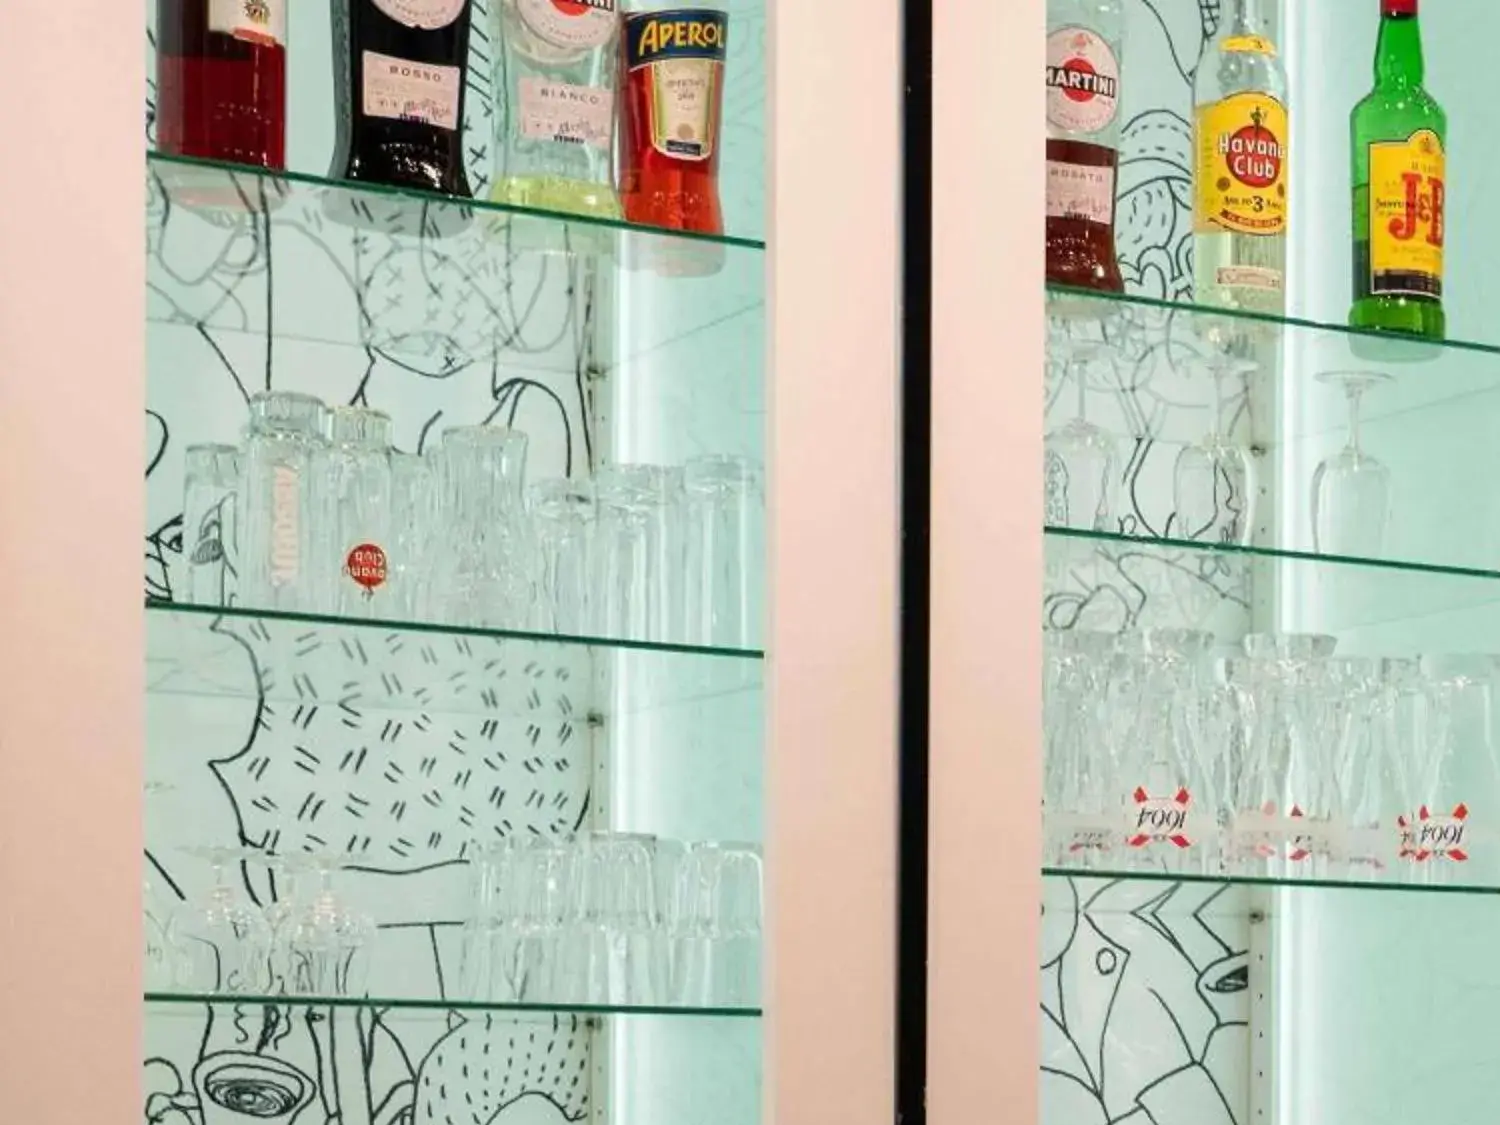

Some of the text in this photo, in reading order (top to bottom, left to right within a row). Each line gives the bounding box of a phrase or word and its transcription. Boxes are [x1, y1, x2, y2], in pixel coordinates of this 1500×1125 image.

[389, 65, 441, 82] ROSSO
[540, 88, 599, 104] BIANCO
[1233, 156, 1275, 179] Club
[1051, 168, 1103, 184] ROSATO
[1252, 195, 1264, 213] 3
[355, 551, 384, 567] Club
